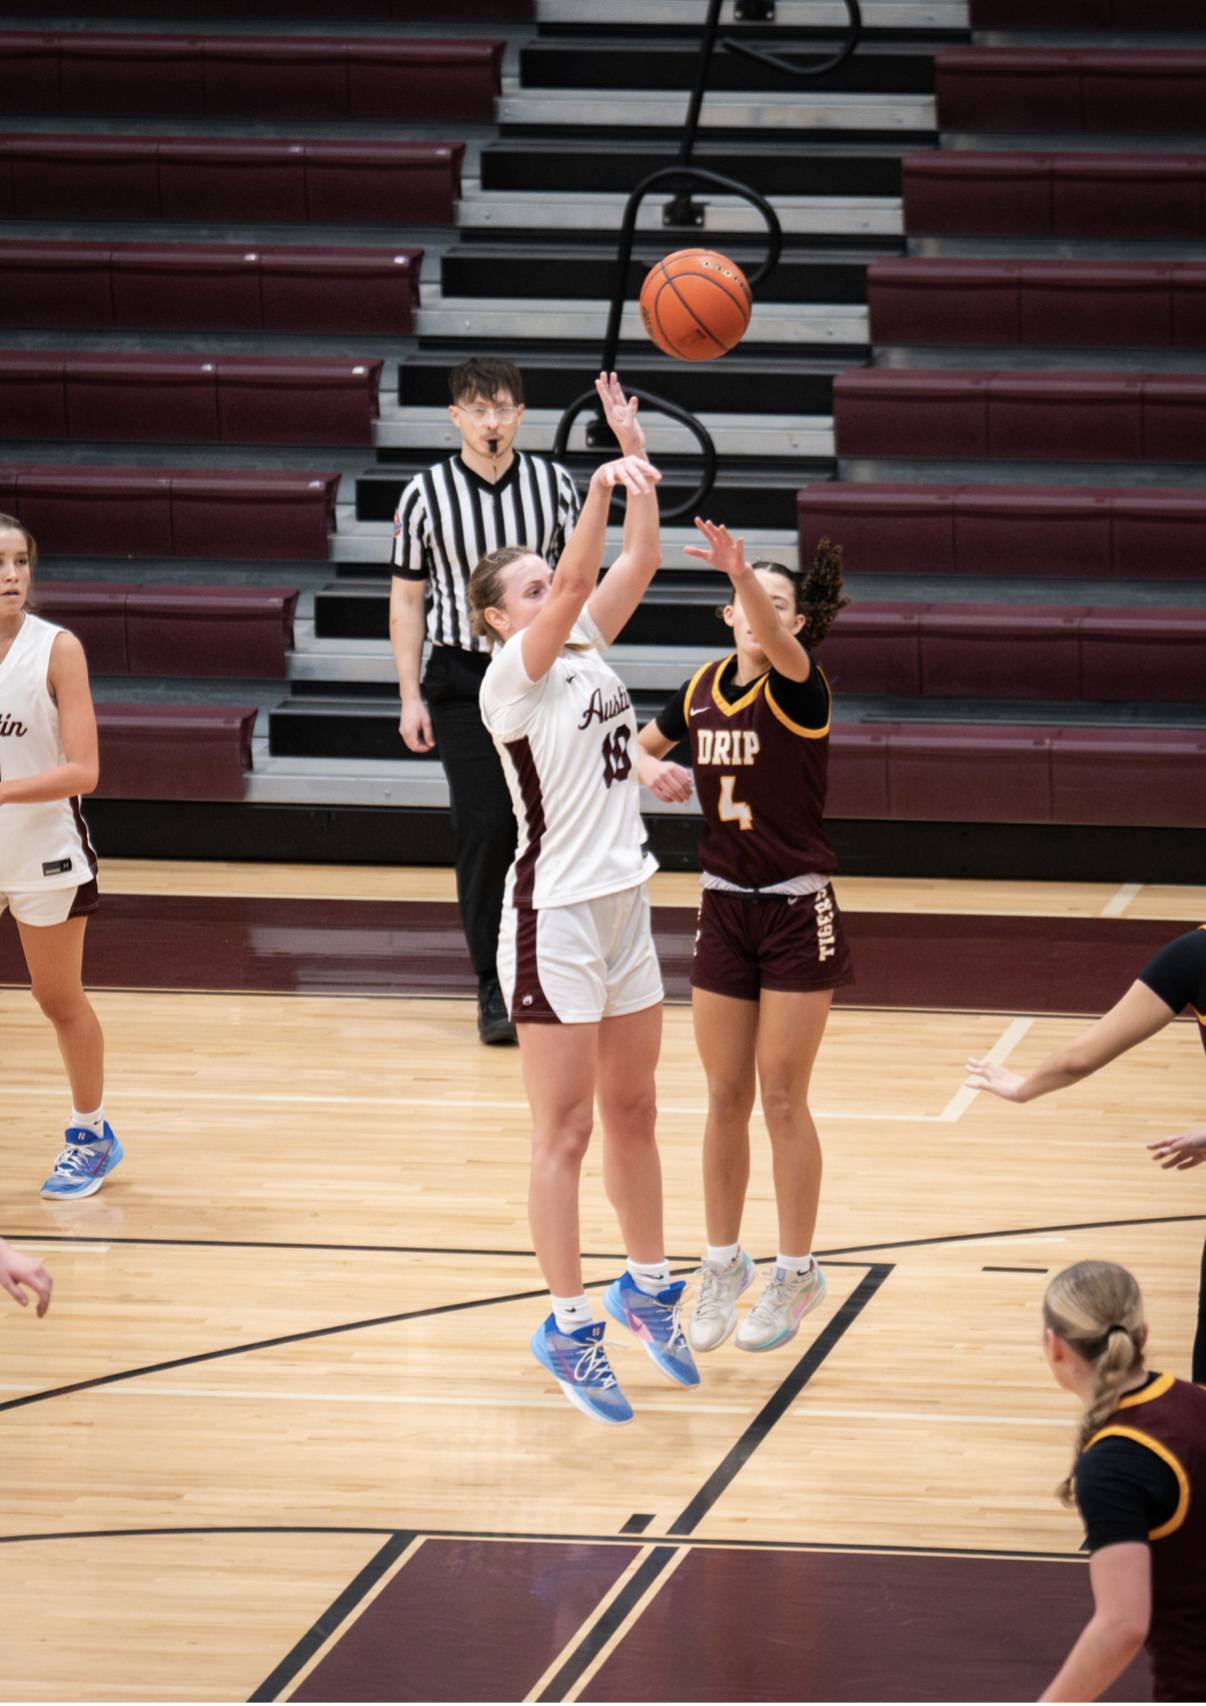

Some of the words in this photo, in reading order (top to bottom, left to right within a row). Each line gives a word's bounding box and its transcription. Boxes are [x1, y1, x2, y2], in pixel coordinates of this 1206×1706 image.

[578, 684, 630, 730] Austi
[602, 723, 632, 789] 10
[697, 729, 760, 765] DRIP
[718, 775, 753, 830] 4
[814, 888, 836, 962] TIGERS
